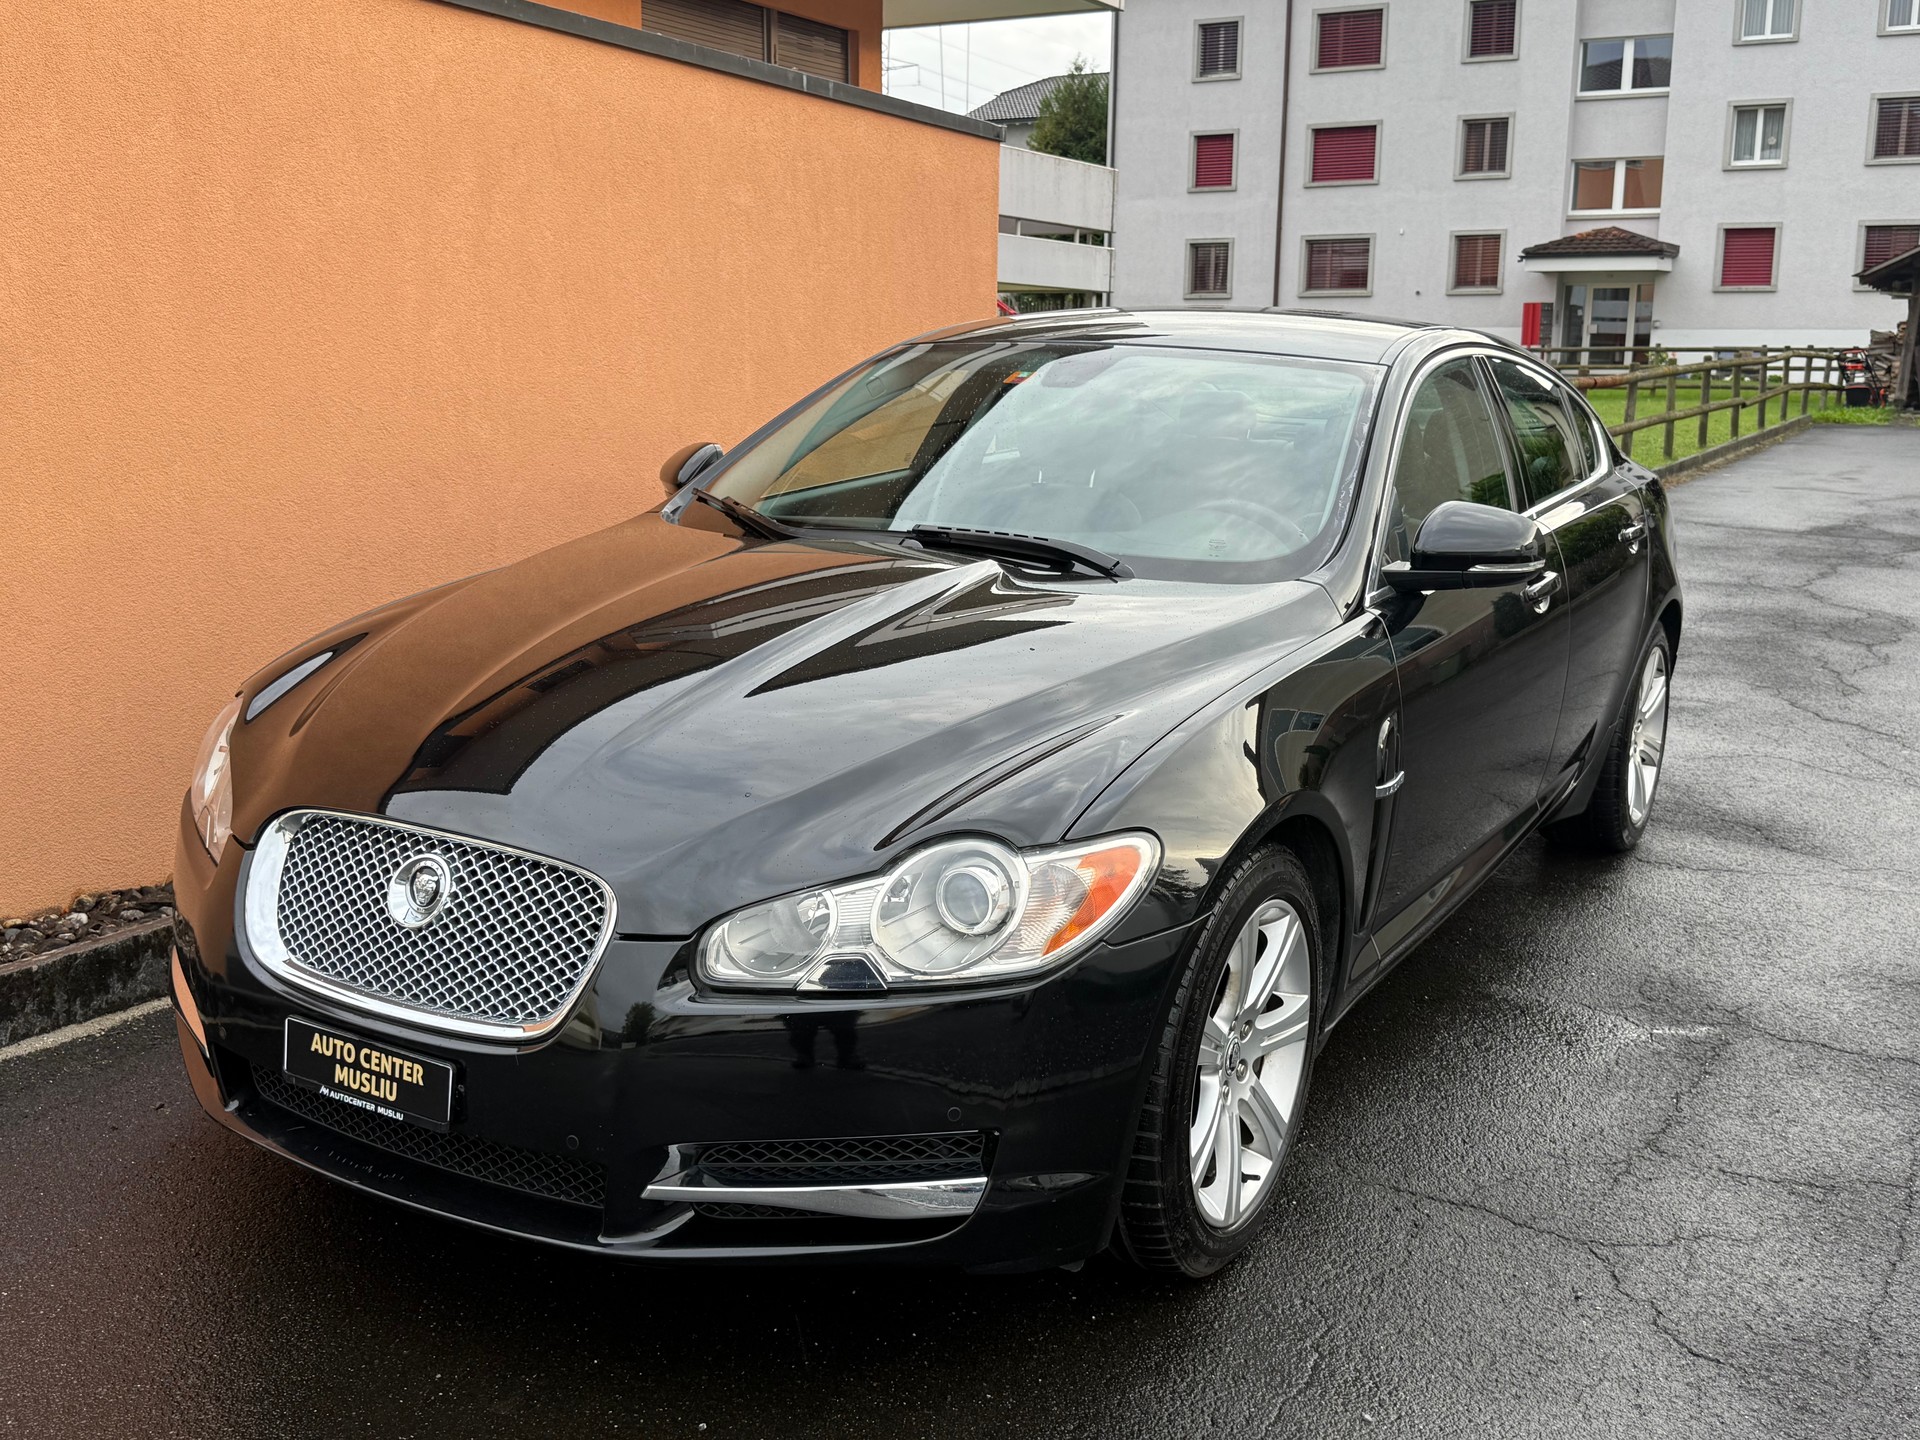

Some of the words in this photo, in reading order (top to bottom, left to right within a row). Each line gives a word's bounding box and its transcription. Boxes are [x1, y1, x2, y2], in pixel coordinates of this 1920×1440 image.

[310, 1032, 356, 1064] AUTO
[359, 1047, 424, 1086] CENTER
[334, 1063, 398, 1102] MUSLIU
[329, 1090, 376, 1112] AUTOCENTER
[377, 1105, 404, 1121] MUSLIU
